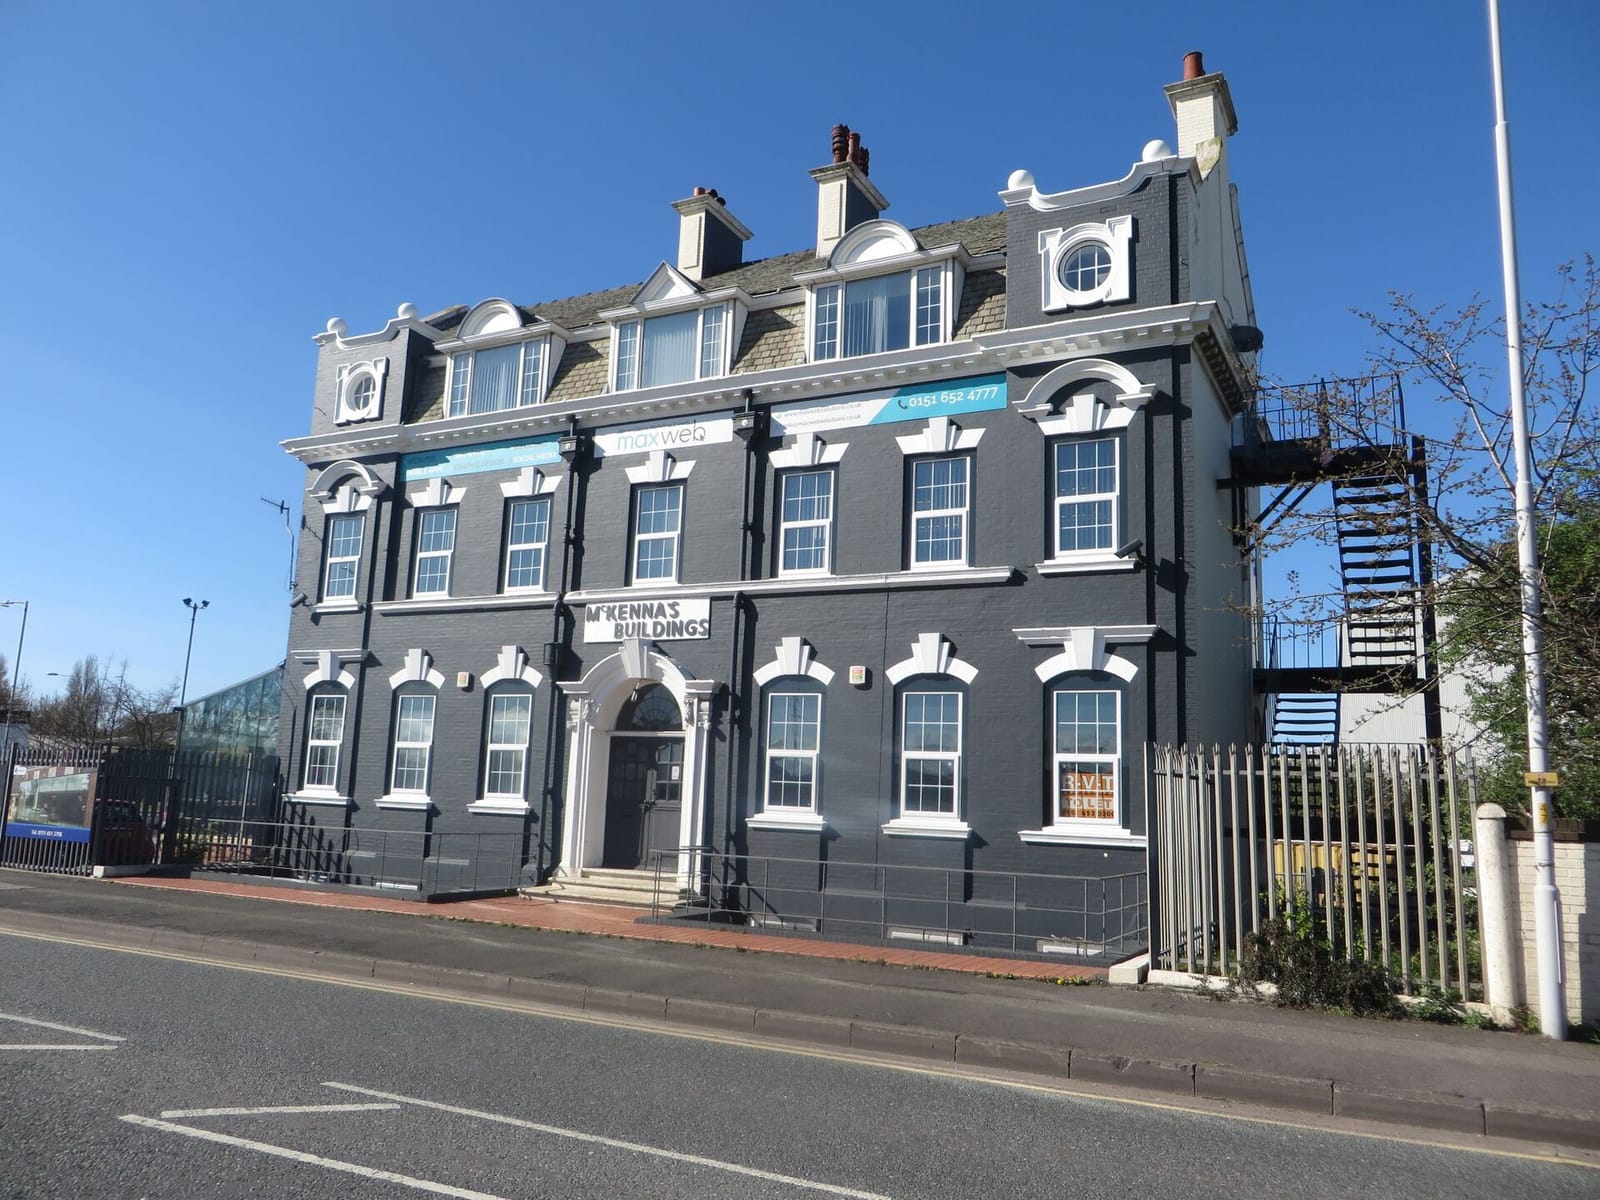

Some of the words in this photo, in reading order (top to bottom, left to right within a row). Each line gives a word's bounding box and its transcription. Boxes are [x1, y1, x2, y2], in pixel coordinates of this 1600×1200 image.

[909, 395, 938, 407] 0151
[940, 391, 964, 404] 652
[967, 386, 999, 401] 4777
[617, 418, 707, 451] maxweb
[614, 618, 709, 640] BUILDINGS
